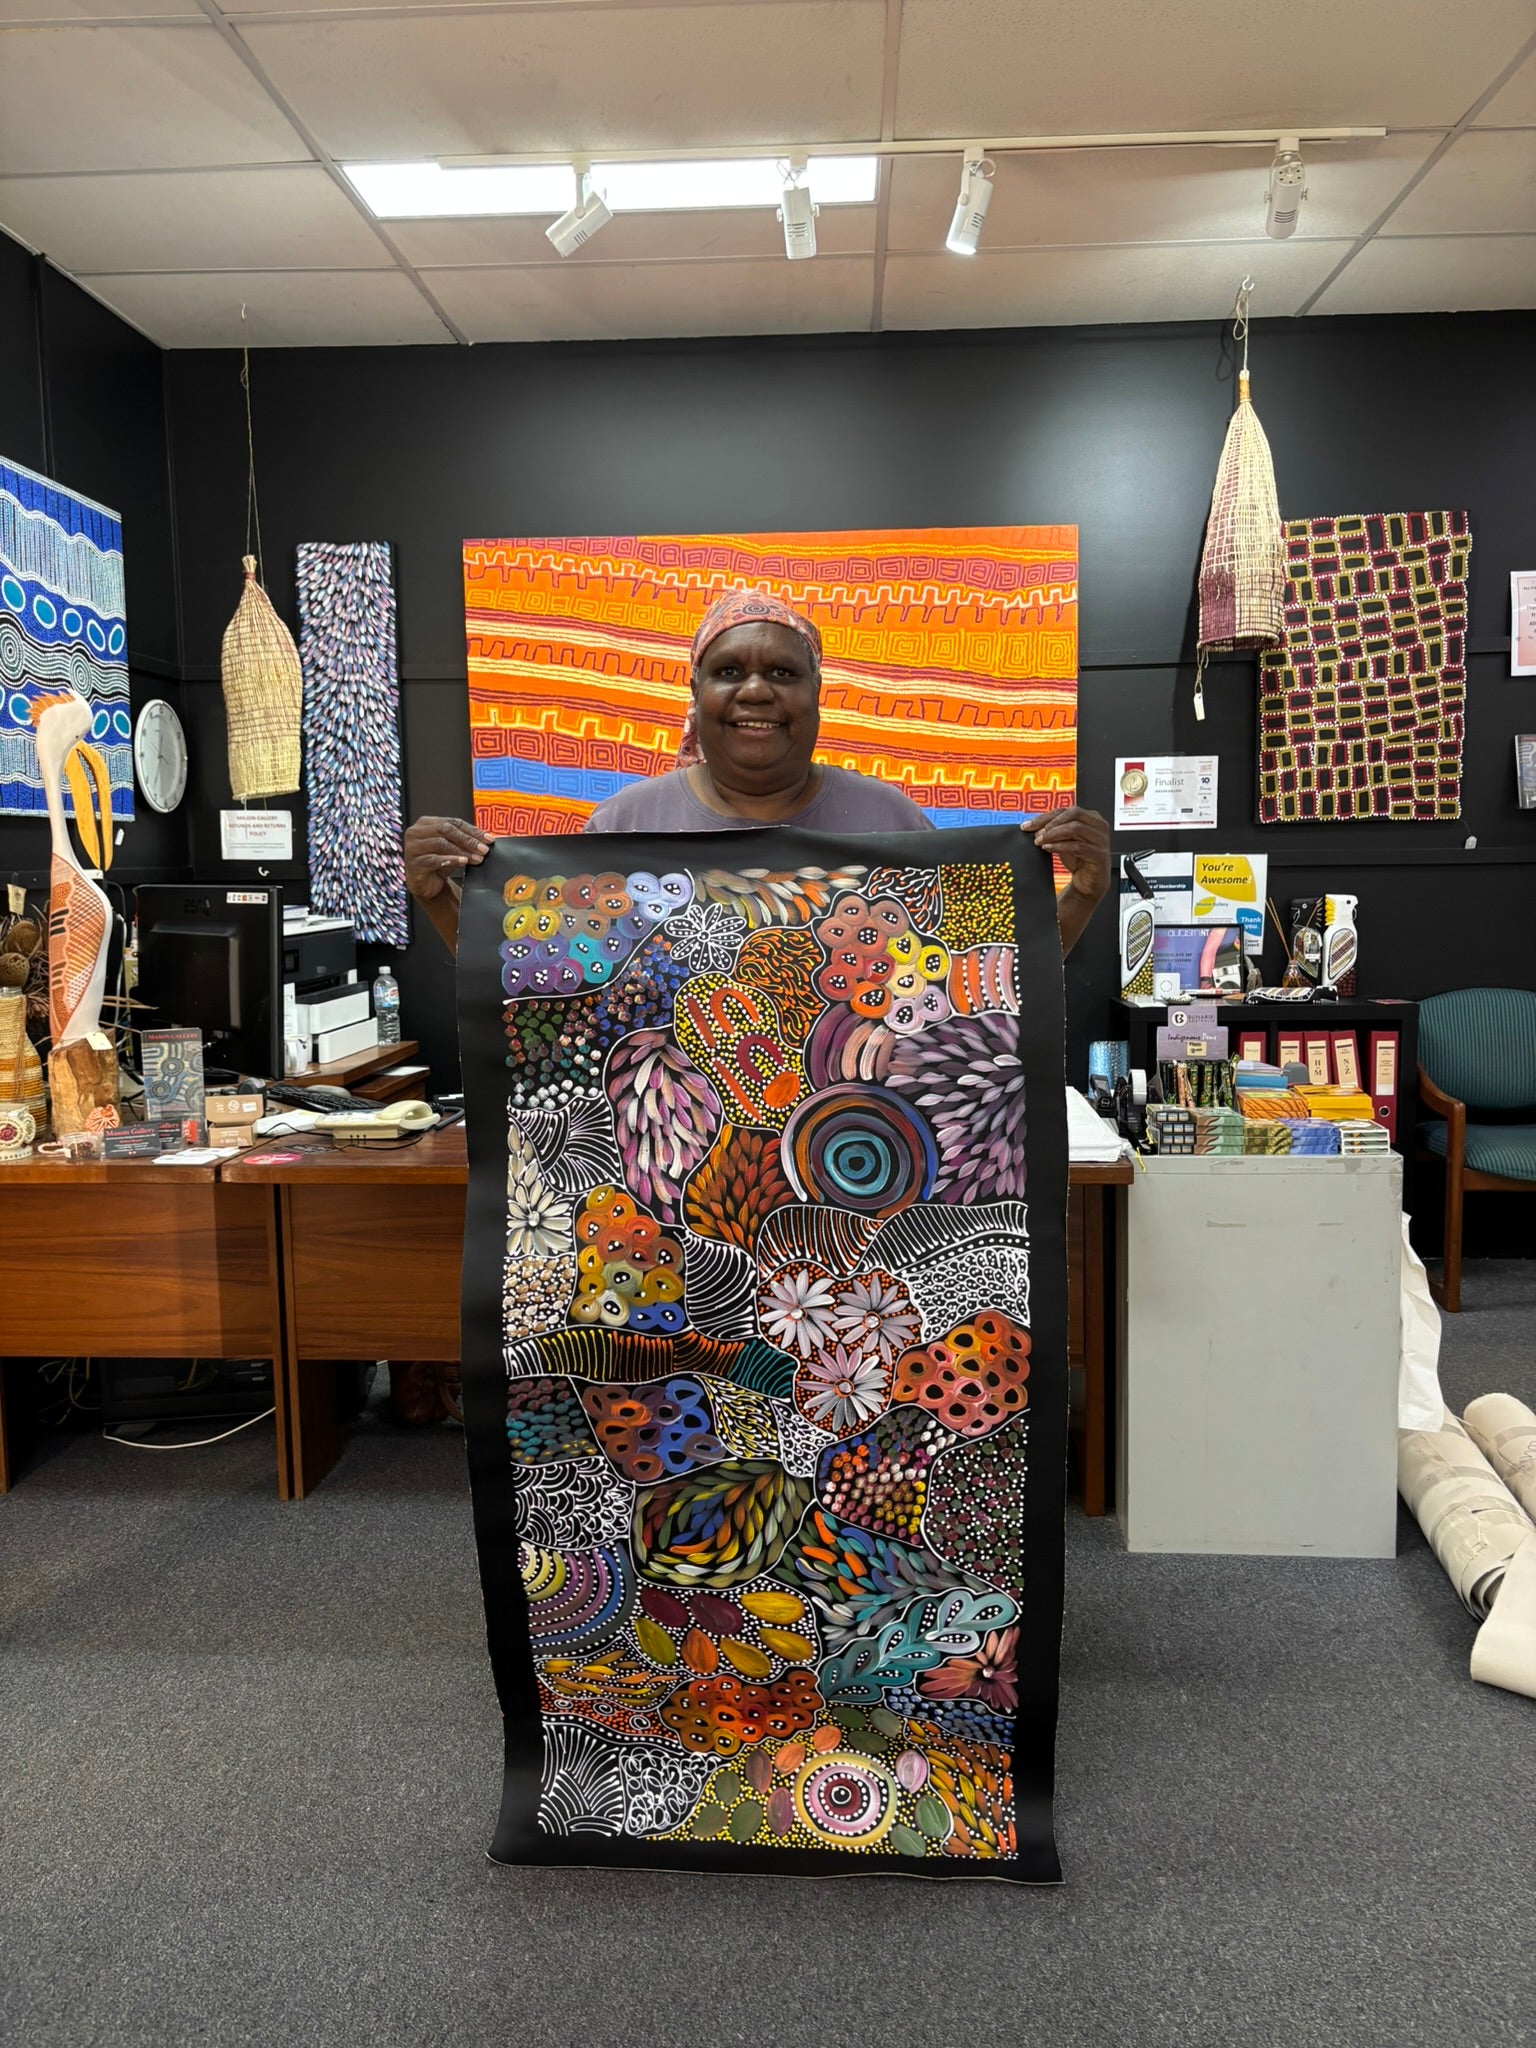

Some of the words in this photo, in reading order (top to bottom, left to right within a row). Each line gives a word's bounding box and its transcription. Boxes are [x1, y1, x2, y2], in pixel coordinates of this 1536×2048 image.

[1155, 777, 1184, 787] Finalist
[1202, 863, 1234, 872] You're
[130, 1127, 155, 1135] Gallery
